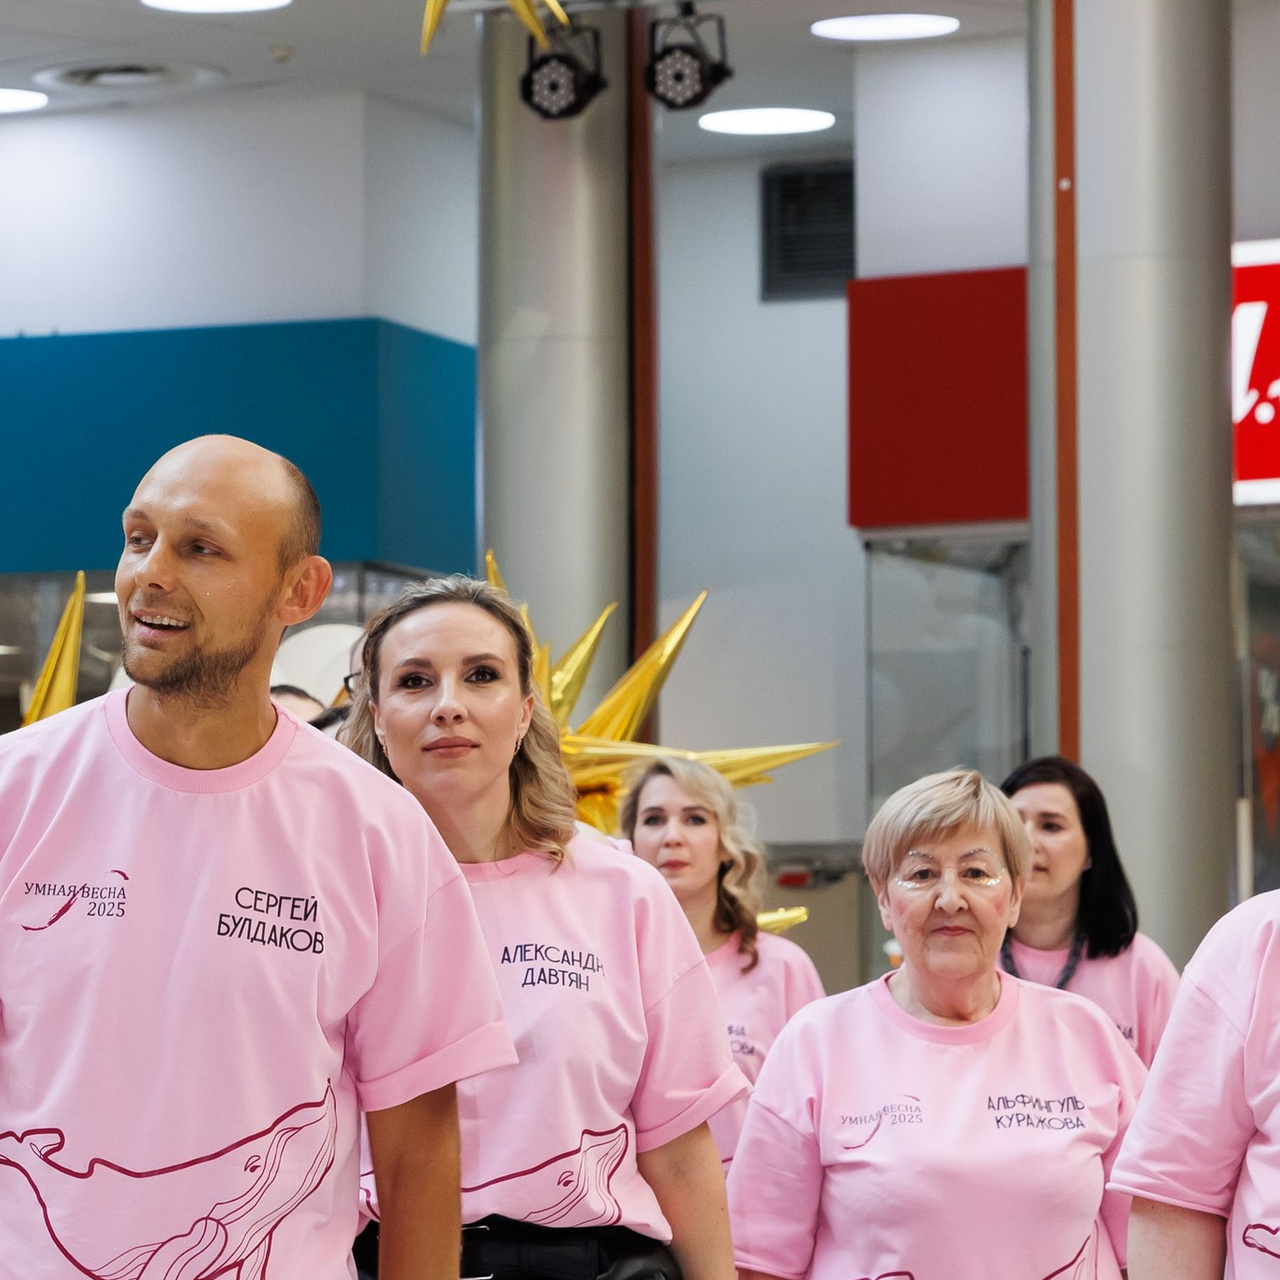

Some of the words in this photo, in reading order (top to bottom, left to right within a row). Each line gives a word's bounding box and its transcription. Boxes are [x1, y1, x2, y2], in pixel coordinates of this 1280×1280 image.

[24, 882, 77, 897] УМНАЯ
[81, 886, 127, 900] ВЕСНА
[87, 901, 126, 918] 2025
[235, 886, 318, 923] СЕРГЕЙ
[217, 913, 325, 954] БУЛДАКОВ
[521, 967, 589, 992] ДАВТЯН
[890, 1113, 923, 1126] 2025
[995, 1113, 1087, 1130] КУРАЖОВА
